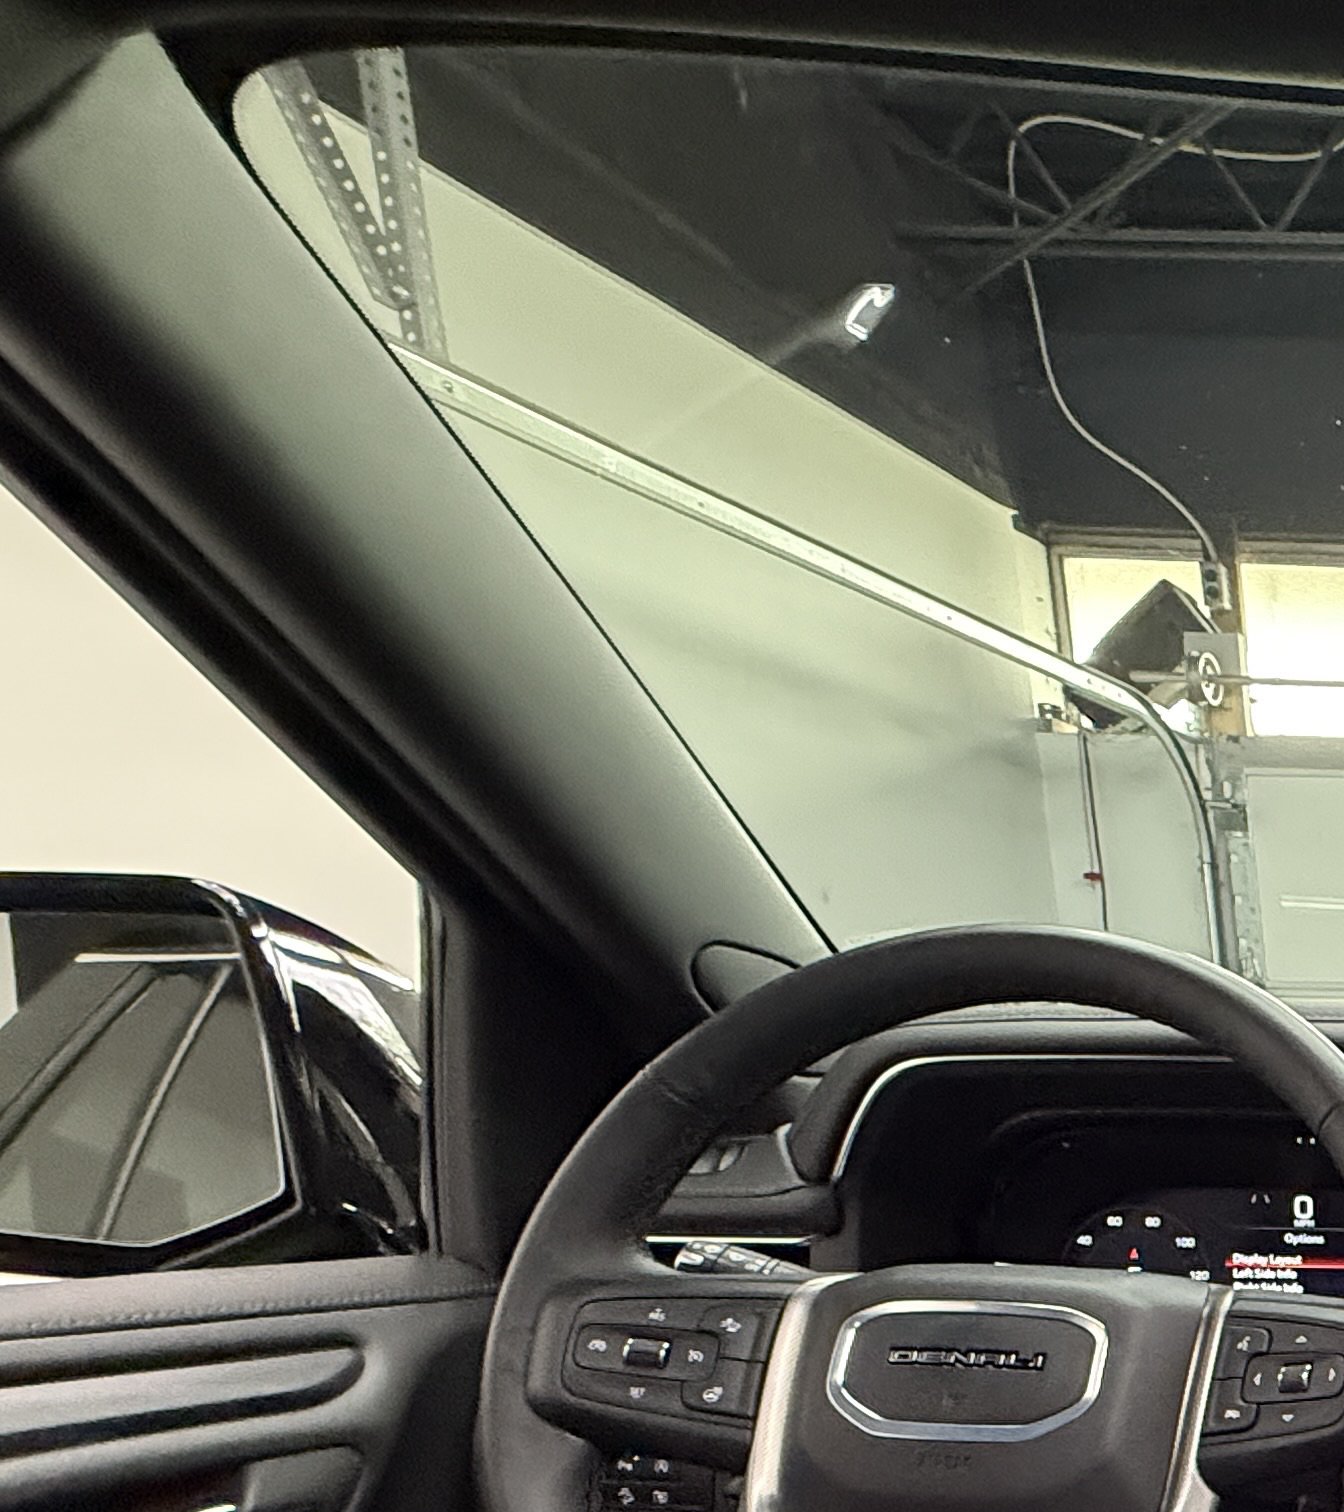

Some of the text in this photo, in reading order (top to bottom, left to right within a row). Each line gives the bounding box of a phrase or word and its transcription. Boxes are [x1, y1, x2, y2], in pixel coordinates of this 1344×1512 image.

[1293, 1194, 1314, 1219] 0
[1284, 1233, 1325, 1246] Options
[1232, 1253, 1302, 1267] Display Layout
[1189, 1270, 1210, 1281] 120
[1232, 1268, 1298, 1279] Left Side Info
[888, 1347, 1047, 1371] DENALI
